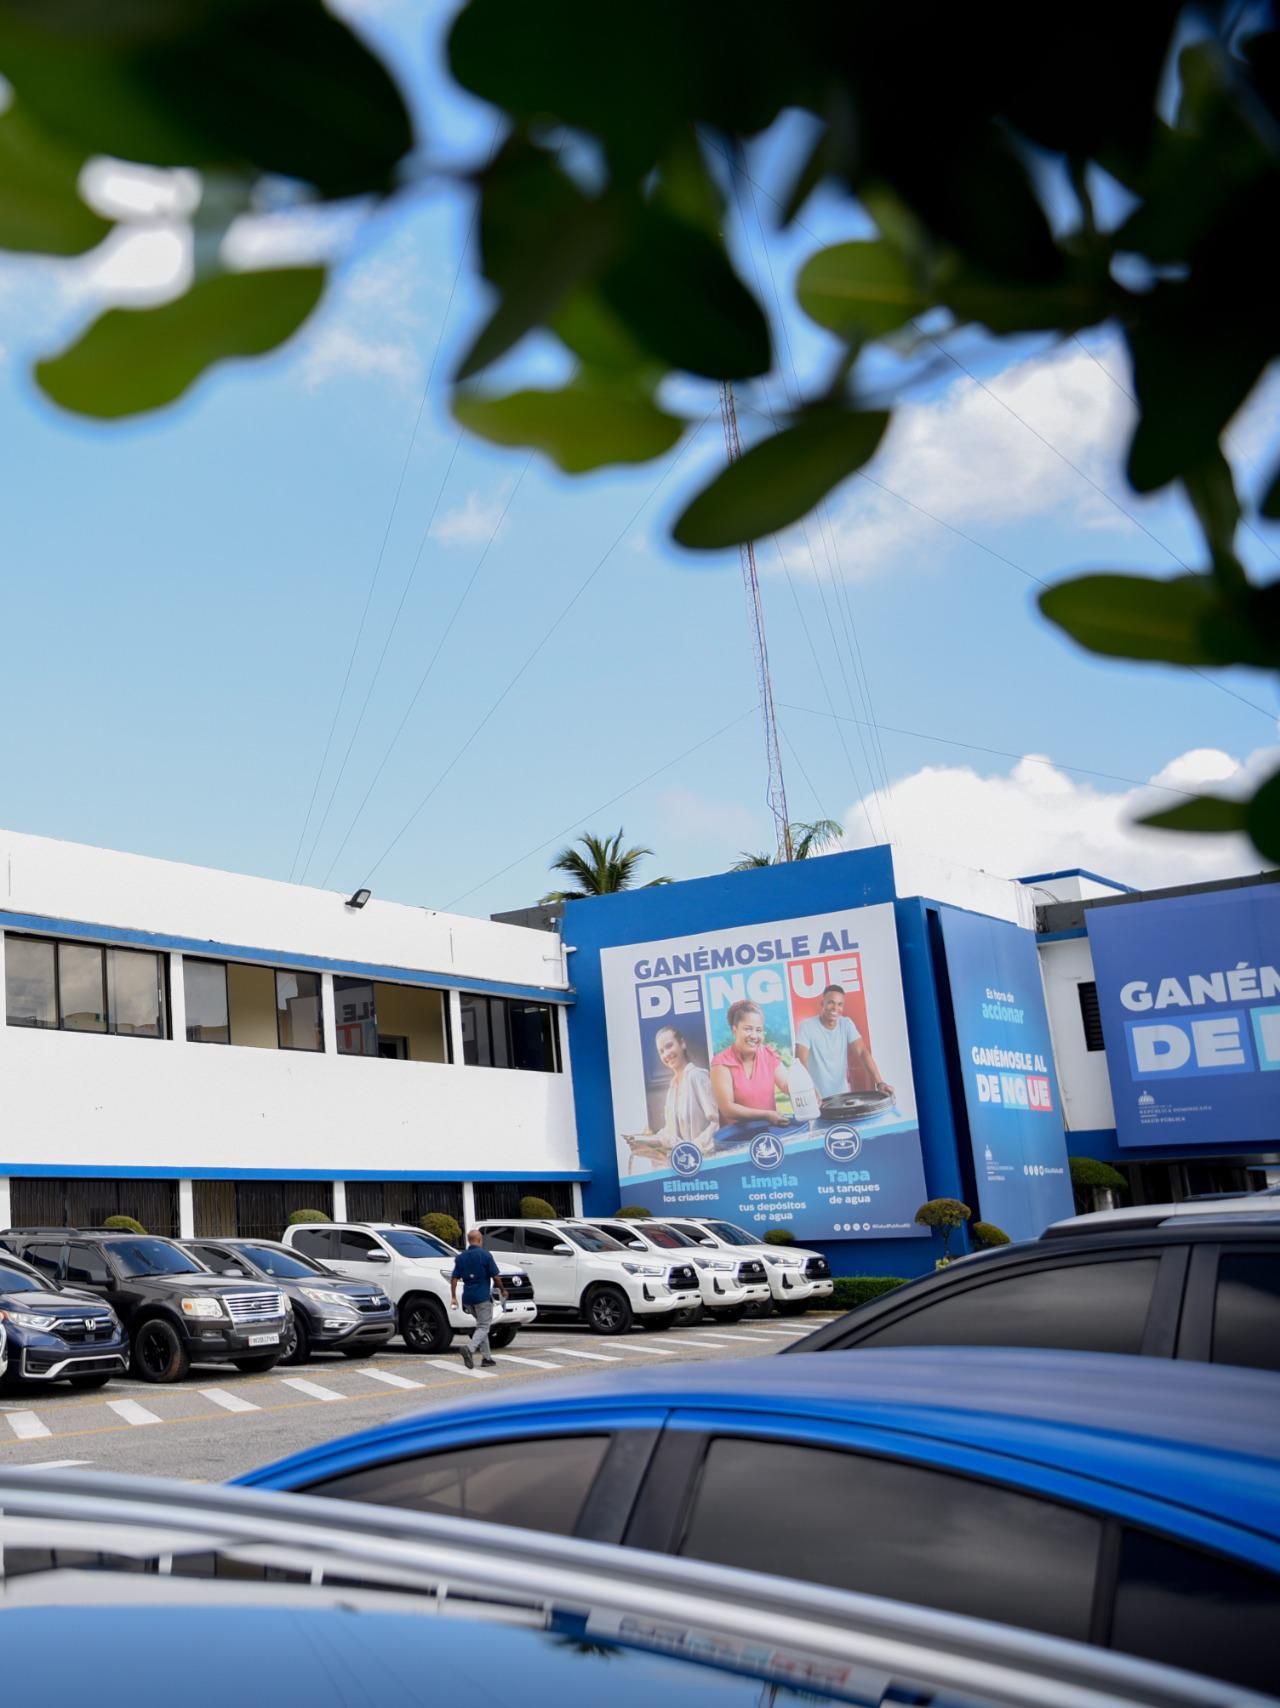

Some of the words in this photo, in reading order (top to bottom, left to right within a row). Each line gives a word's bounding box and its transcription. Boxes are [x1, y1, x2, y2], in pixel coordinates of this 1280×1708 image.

[634, 935, 810, 980] GANÉMOSLE
[818, 929, 859, 954] AL
[982, 1001, 1024, 1024] accionar
[972, 1045, 1033, 1071] GANÉMOSLE
[1034, 1055, 1048, 1072] AL
[741, 1173, 799, 1190] Limpia
[825, 1169, 871, 1185] Tapa
[663, 1179, 719, 1193] Elimina
[817, 1185, 835, 1194] tus
[837, 1184, 880, 1194] tanques
[663, 1194, 677, 1203] los
[678, 1192, 720, 1202] criaderos
[749, 1193, 767, 1201] con
[769, 1191, 794, 1200] cloro
[829, 1195, 843, 1204] de
[845, 1195, 871, 1205] agua
[739, 1204, 755, 1212] tus
[757, 1201, 807, 1212] depósitos
[753, 1212, 767, 1221] de
[769, 1212, 793, 1222] agua
